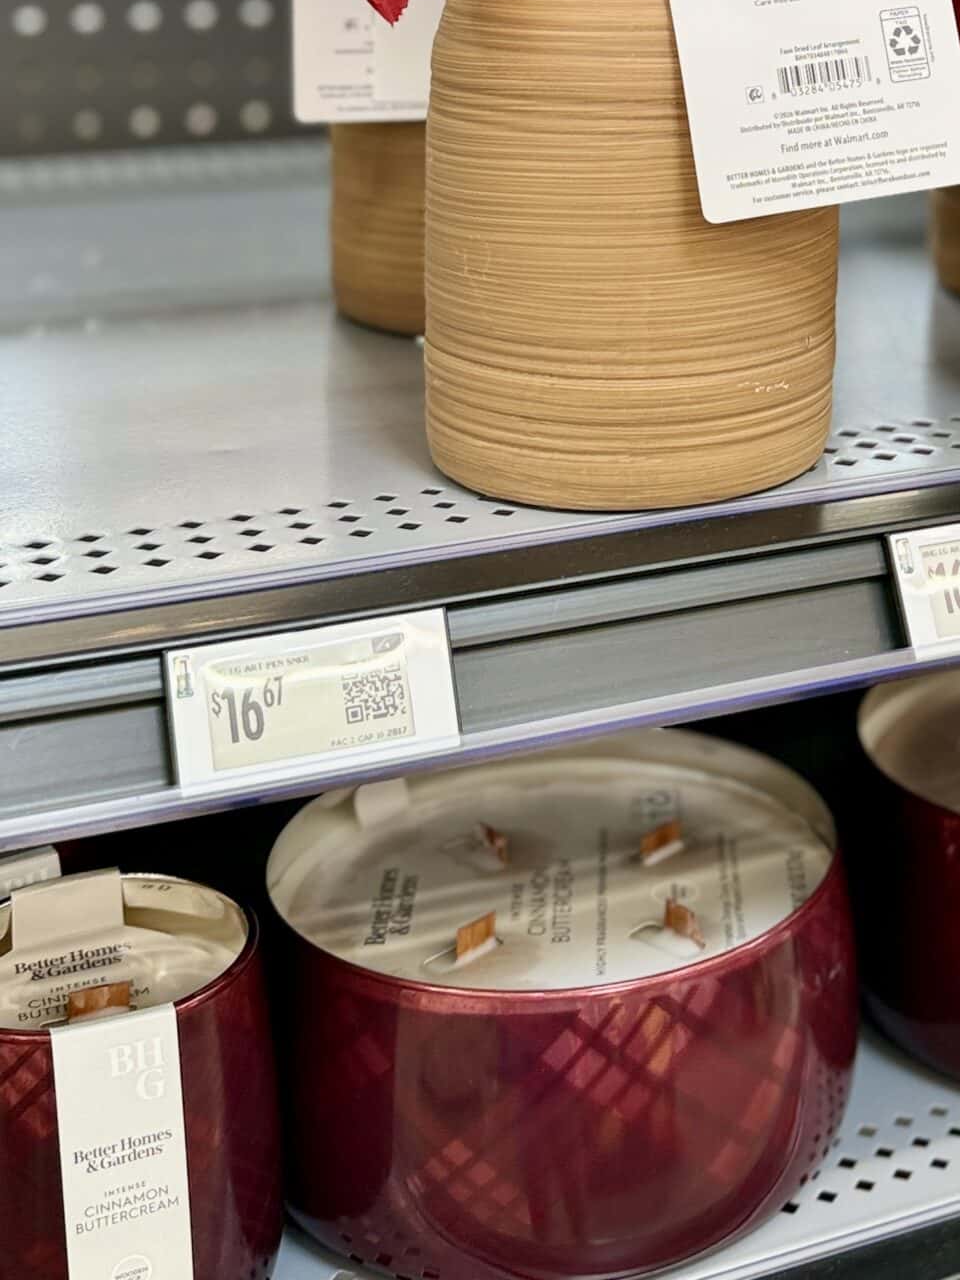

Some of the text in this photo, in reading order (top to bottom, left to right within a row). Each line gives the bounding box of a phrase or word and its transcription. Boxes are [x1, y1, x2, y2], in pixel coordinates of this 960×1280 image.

[780, 129, 889, 153] Find more at Walmart.com
[14, 942, 131, 974] Better Homes
[48, 954, 123, 976] Gardens
[50, 976, 107, 993] INTENSE
[73, 1129, 173, 1164] Better Homes
[100, 1145, 163, 1169] Gardens
[104, 1180, 146, 1197] INTENSE
[84, 1185, 169, 1218] CINNAMON
[75, 1196, 180, 1235] BUTTERCREAM
